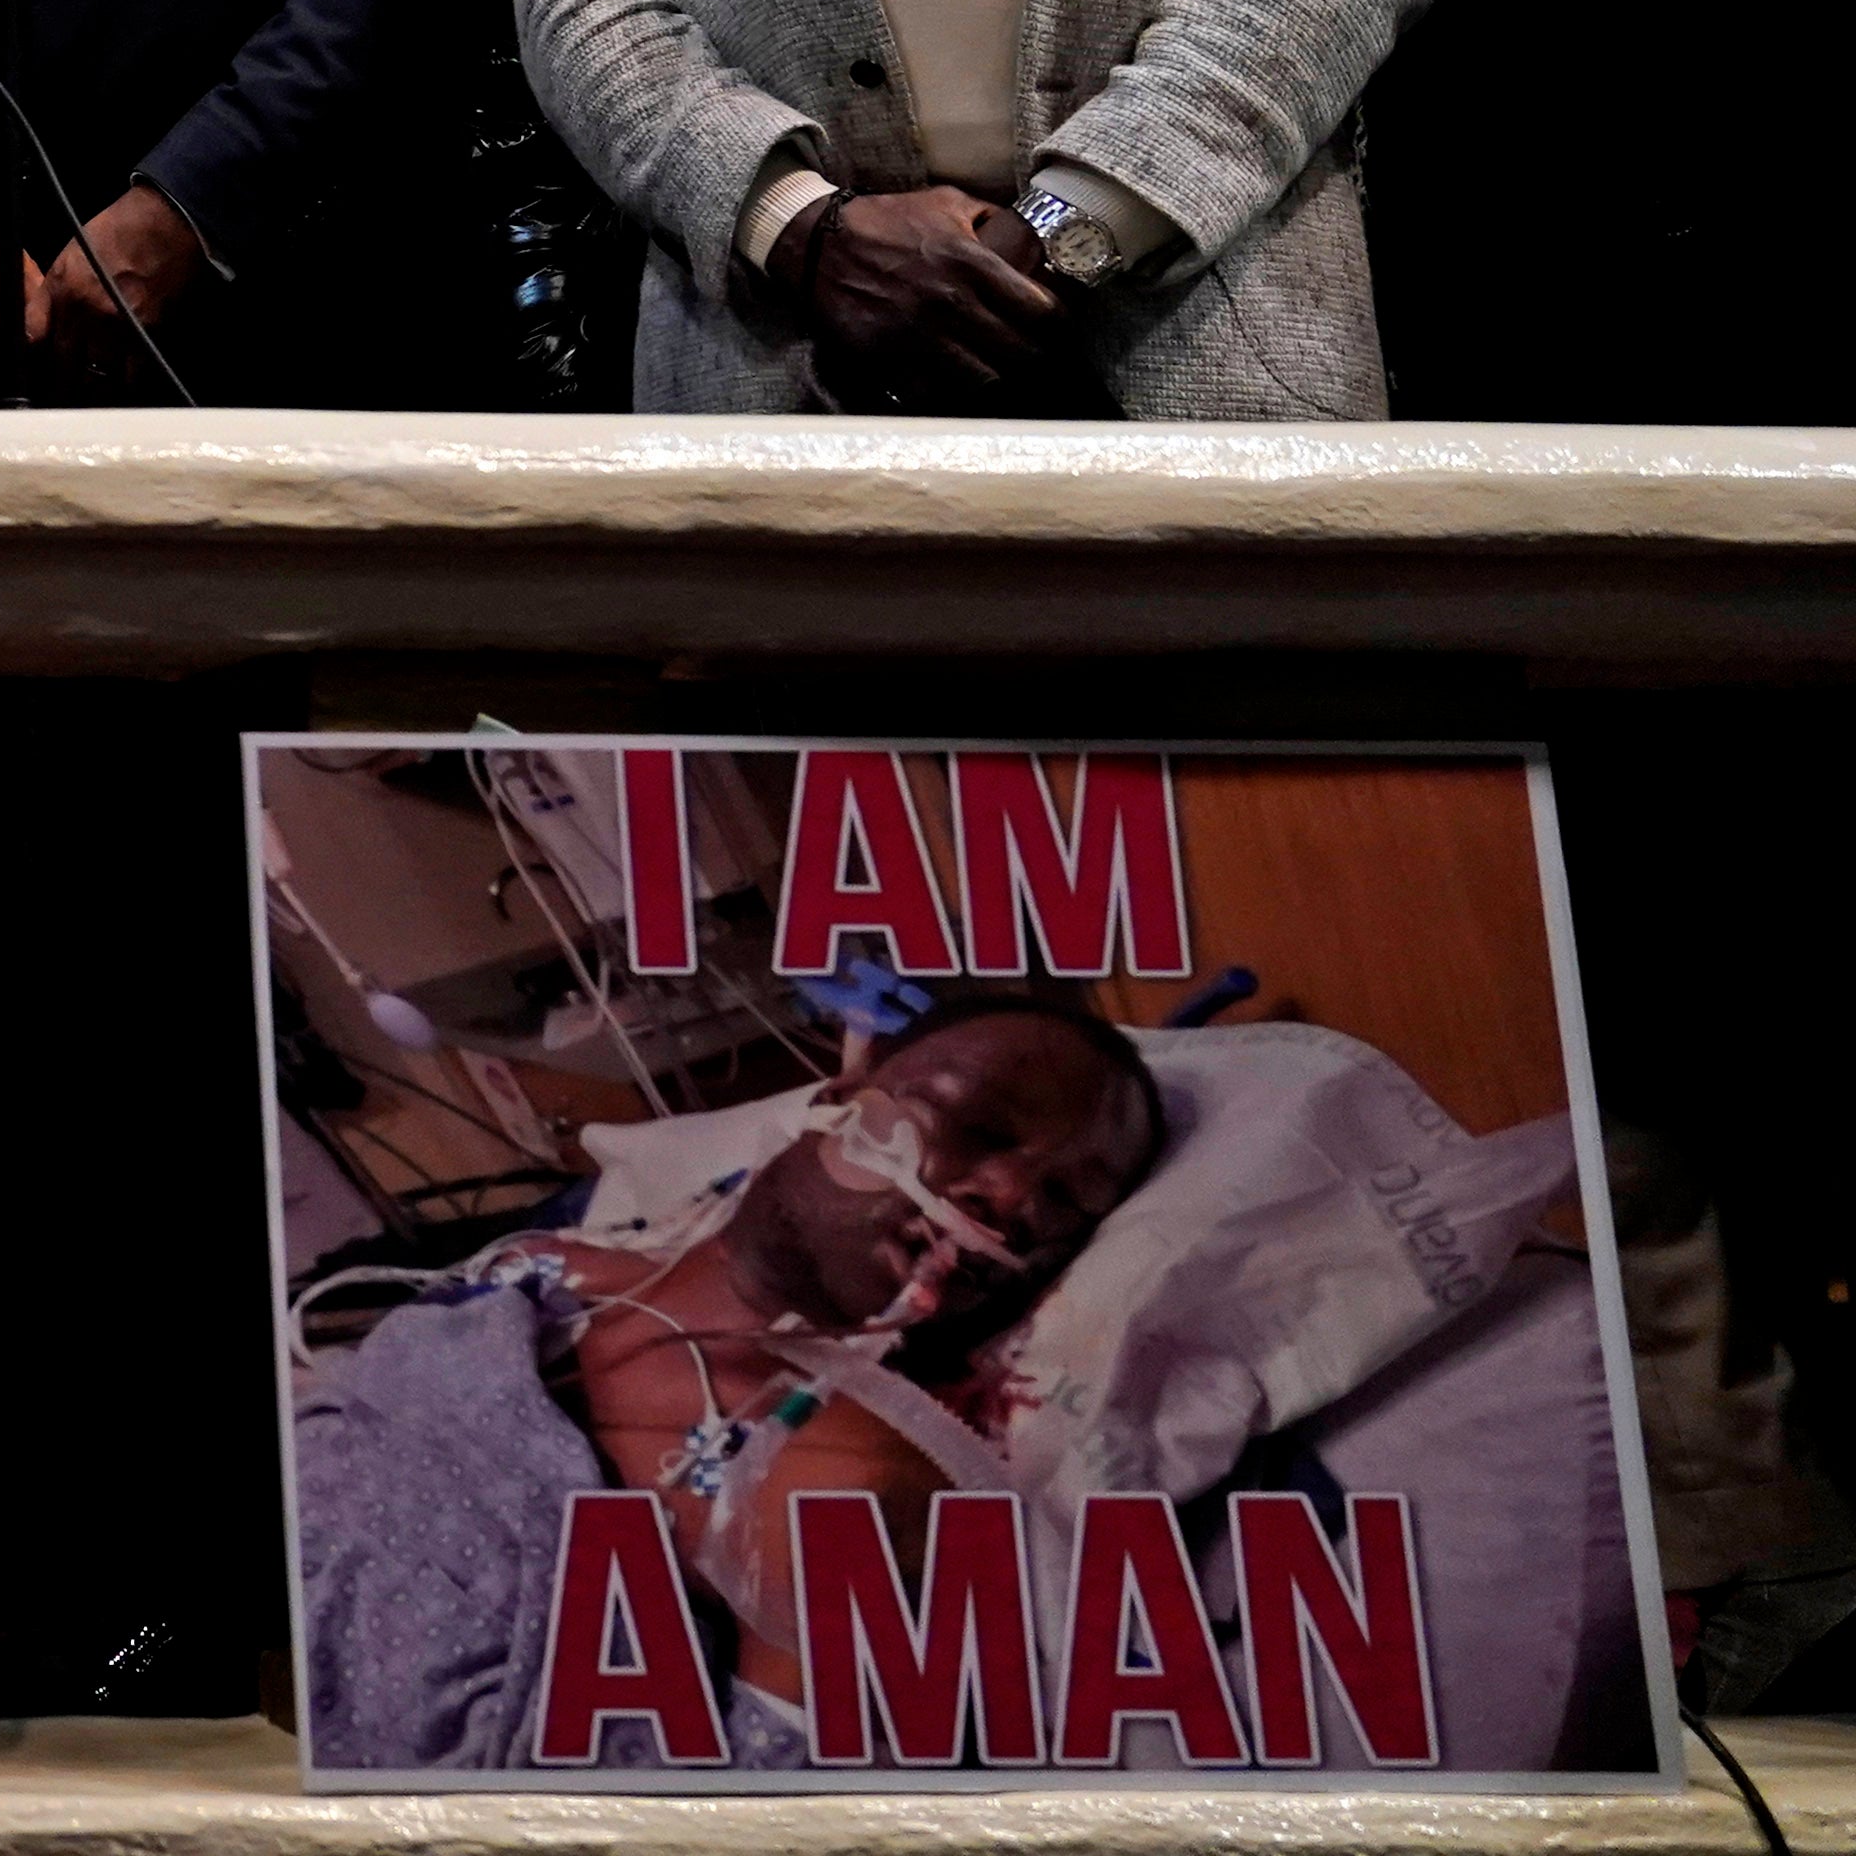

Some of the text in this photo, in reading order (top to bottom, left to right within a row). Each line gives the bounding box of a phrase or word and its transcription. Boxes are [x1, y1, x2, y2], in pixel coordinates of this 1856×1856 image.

[616, 747, 1192, 977] I AM
[530, 1489, 1441, 1768] A MAN
